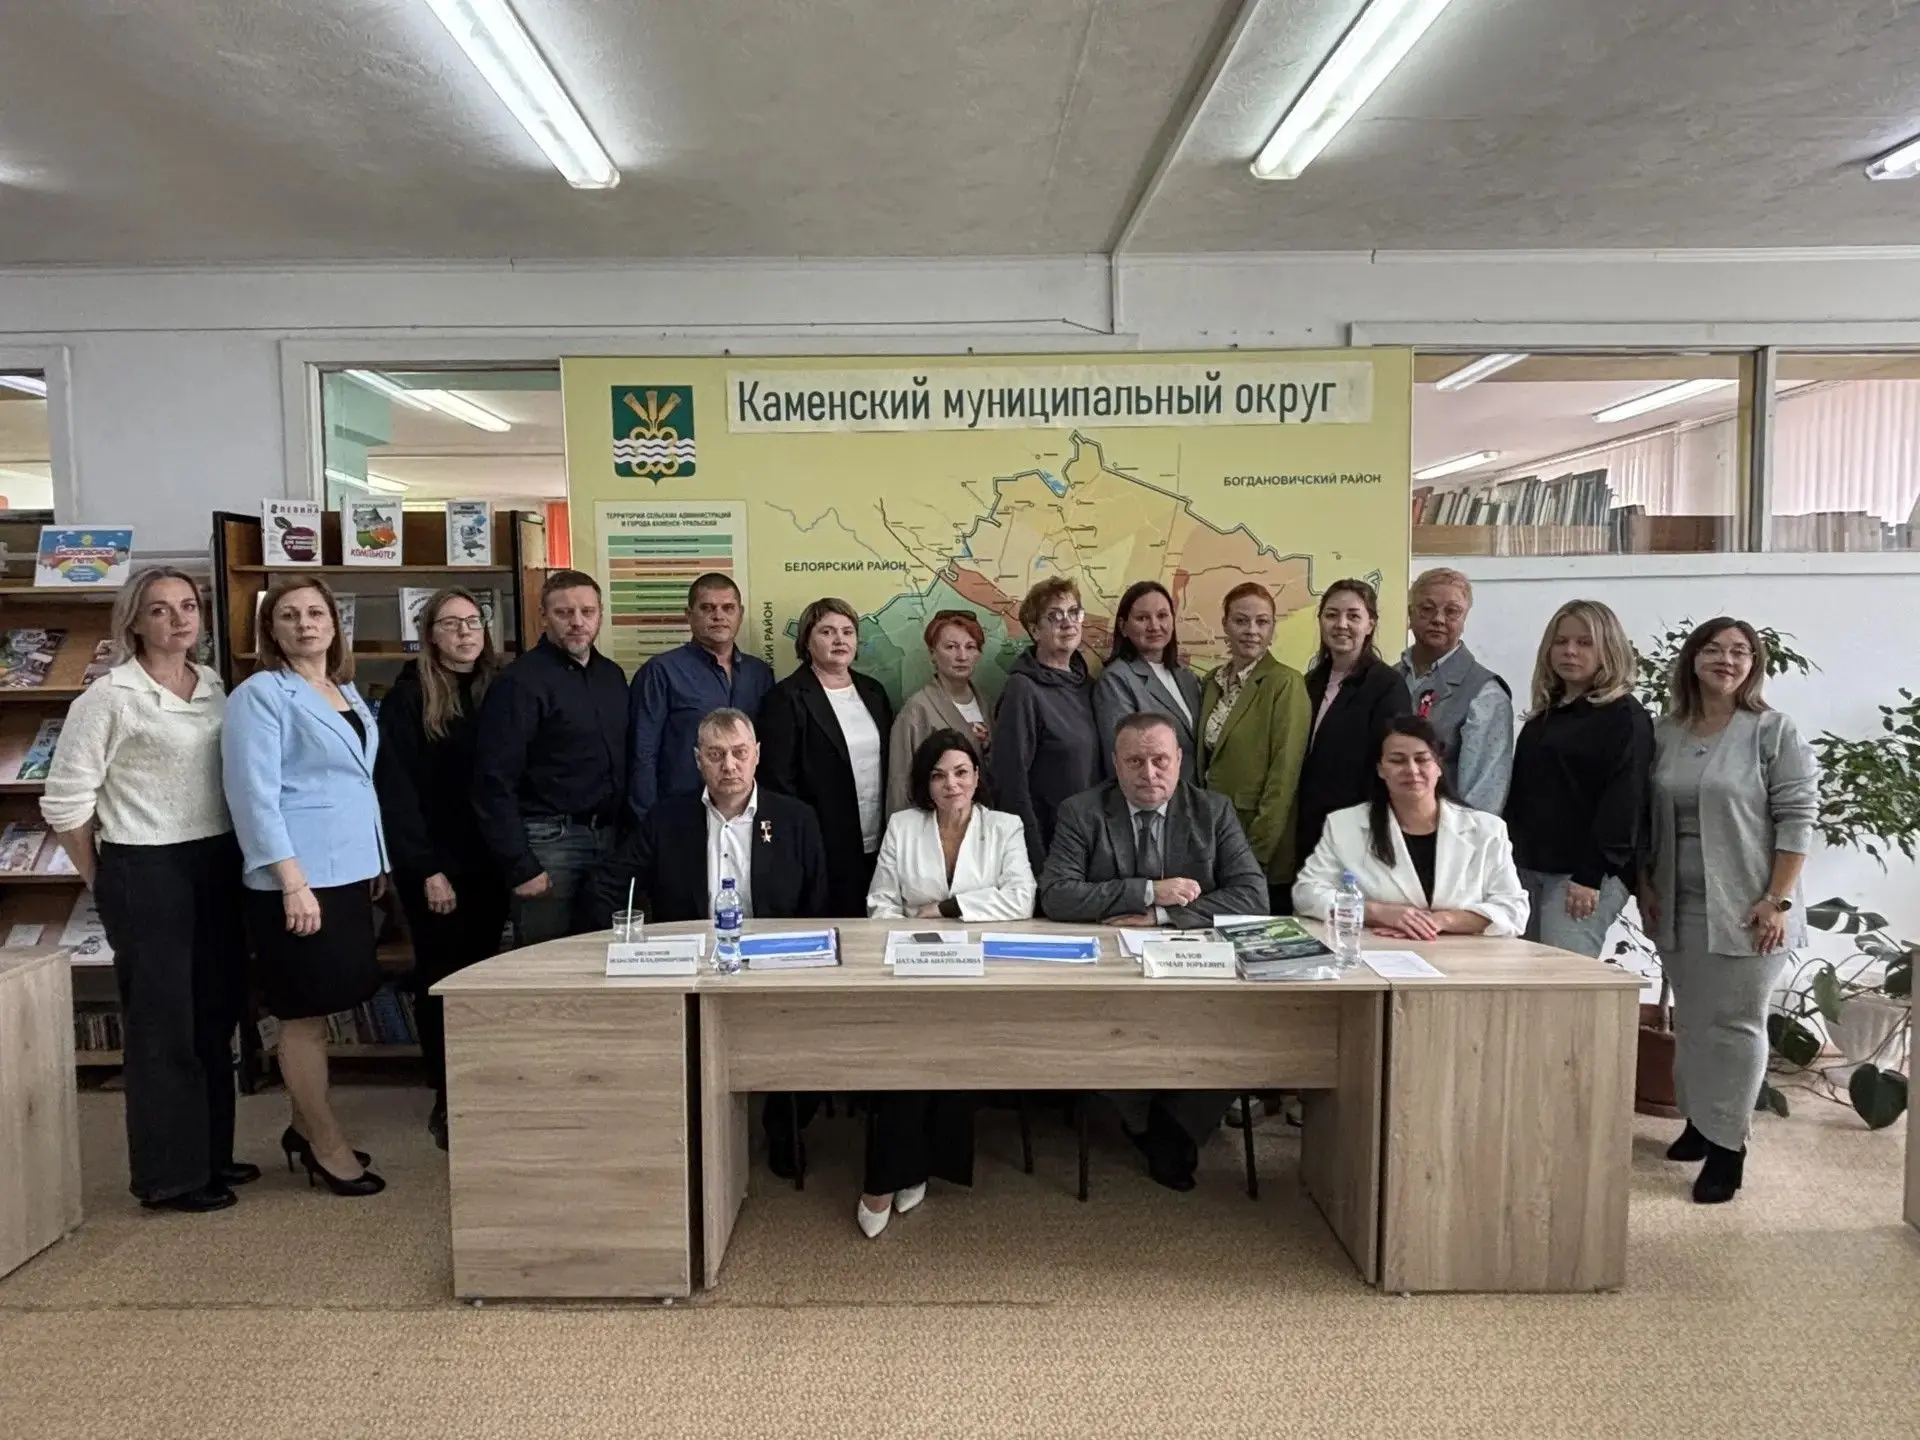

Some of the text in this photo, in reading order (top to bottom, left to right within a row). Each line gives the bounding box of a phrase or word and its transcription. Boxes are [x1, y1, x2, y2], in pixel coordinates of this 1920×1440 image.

[738, 370, 1337, 428] Каменский муниципальный округ
[1224, 473, 1382, 487] БОГДАНОВИЧСКИЙ РАЙОН
[606, 512, 646, 520] ТЕРРИТОРИИ
[678, 511, 732, 519] АДМИНИСТРАЦИЙ
[652, 519, 718, 527] КАМЕНСК-УРАЛЬСКИЙ
[350, 548, 397, 560] КОМПЬЮТЕР
[784, 560, 907, 572] БЕЛОЯРСКИЙ РАЙОН
[762, 601, 774, 641] РАЙОН
